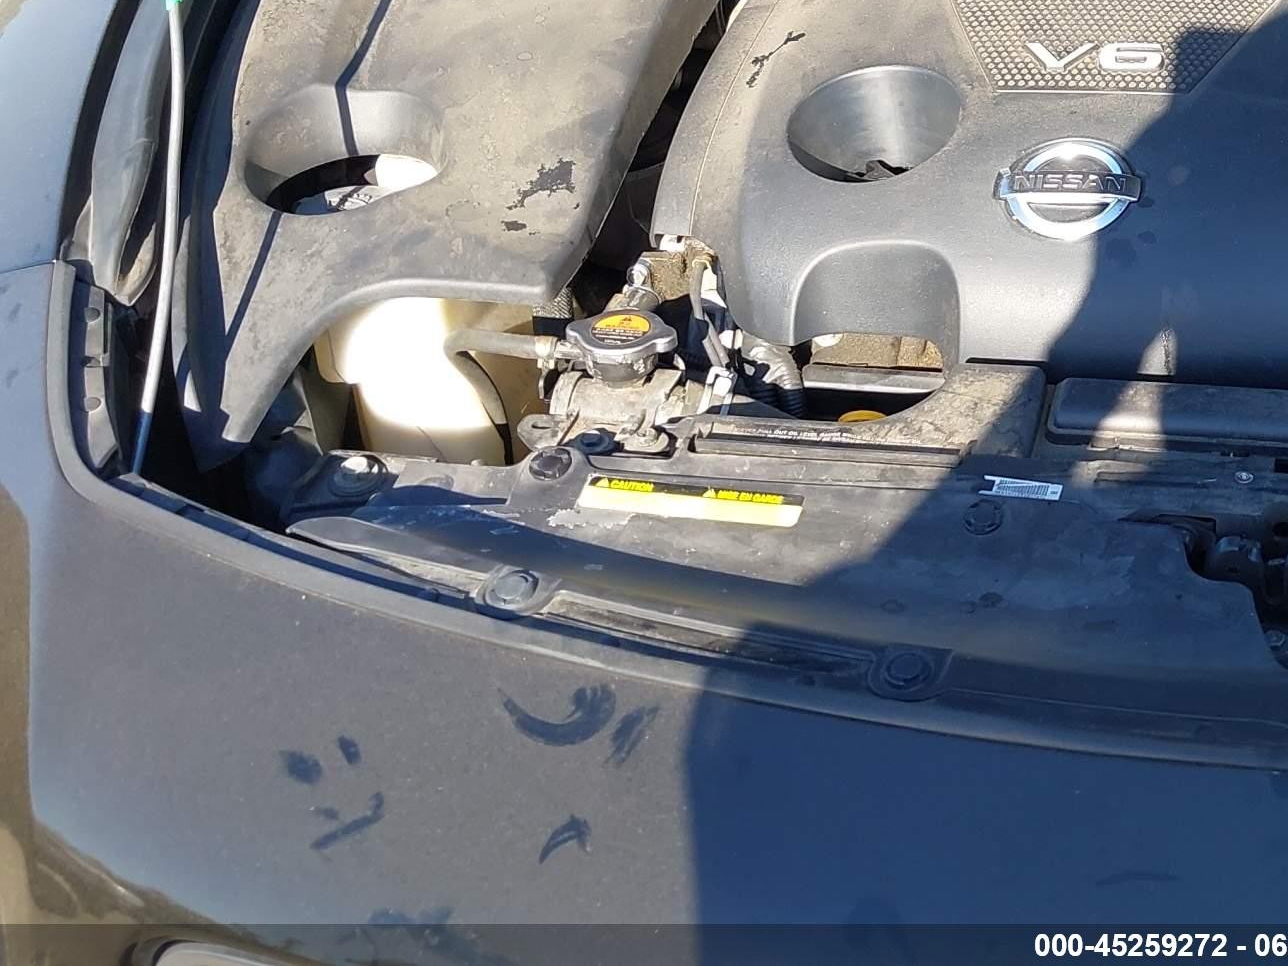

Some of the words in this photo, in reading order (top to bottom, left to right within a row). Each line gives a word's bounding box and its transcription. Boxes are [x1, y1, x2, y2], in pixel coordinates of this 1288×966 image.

[1025, 41, 1165, 73] V6
[1014, 174, 1127, 191] NISSAN
[610, 479, 654, 492] CAUTION
